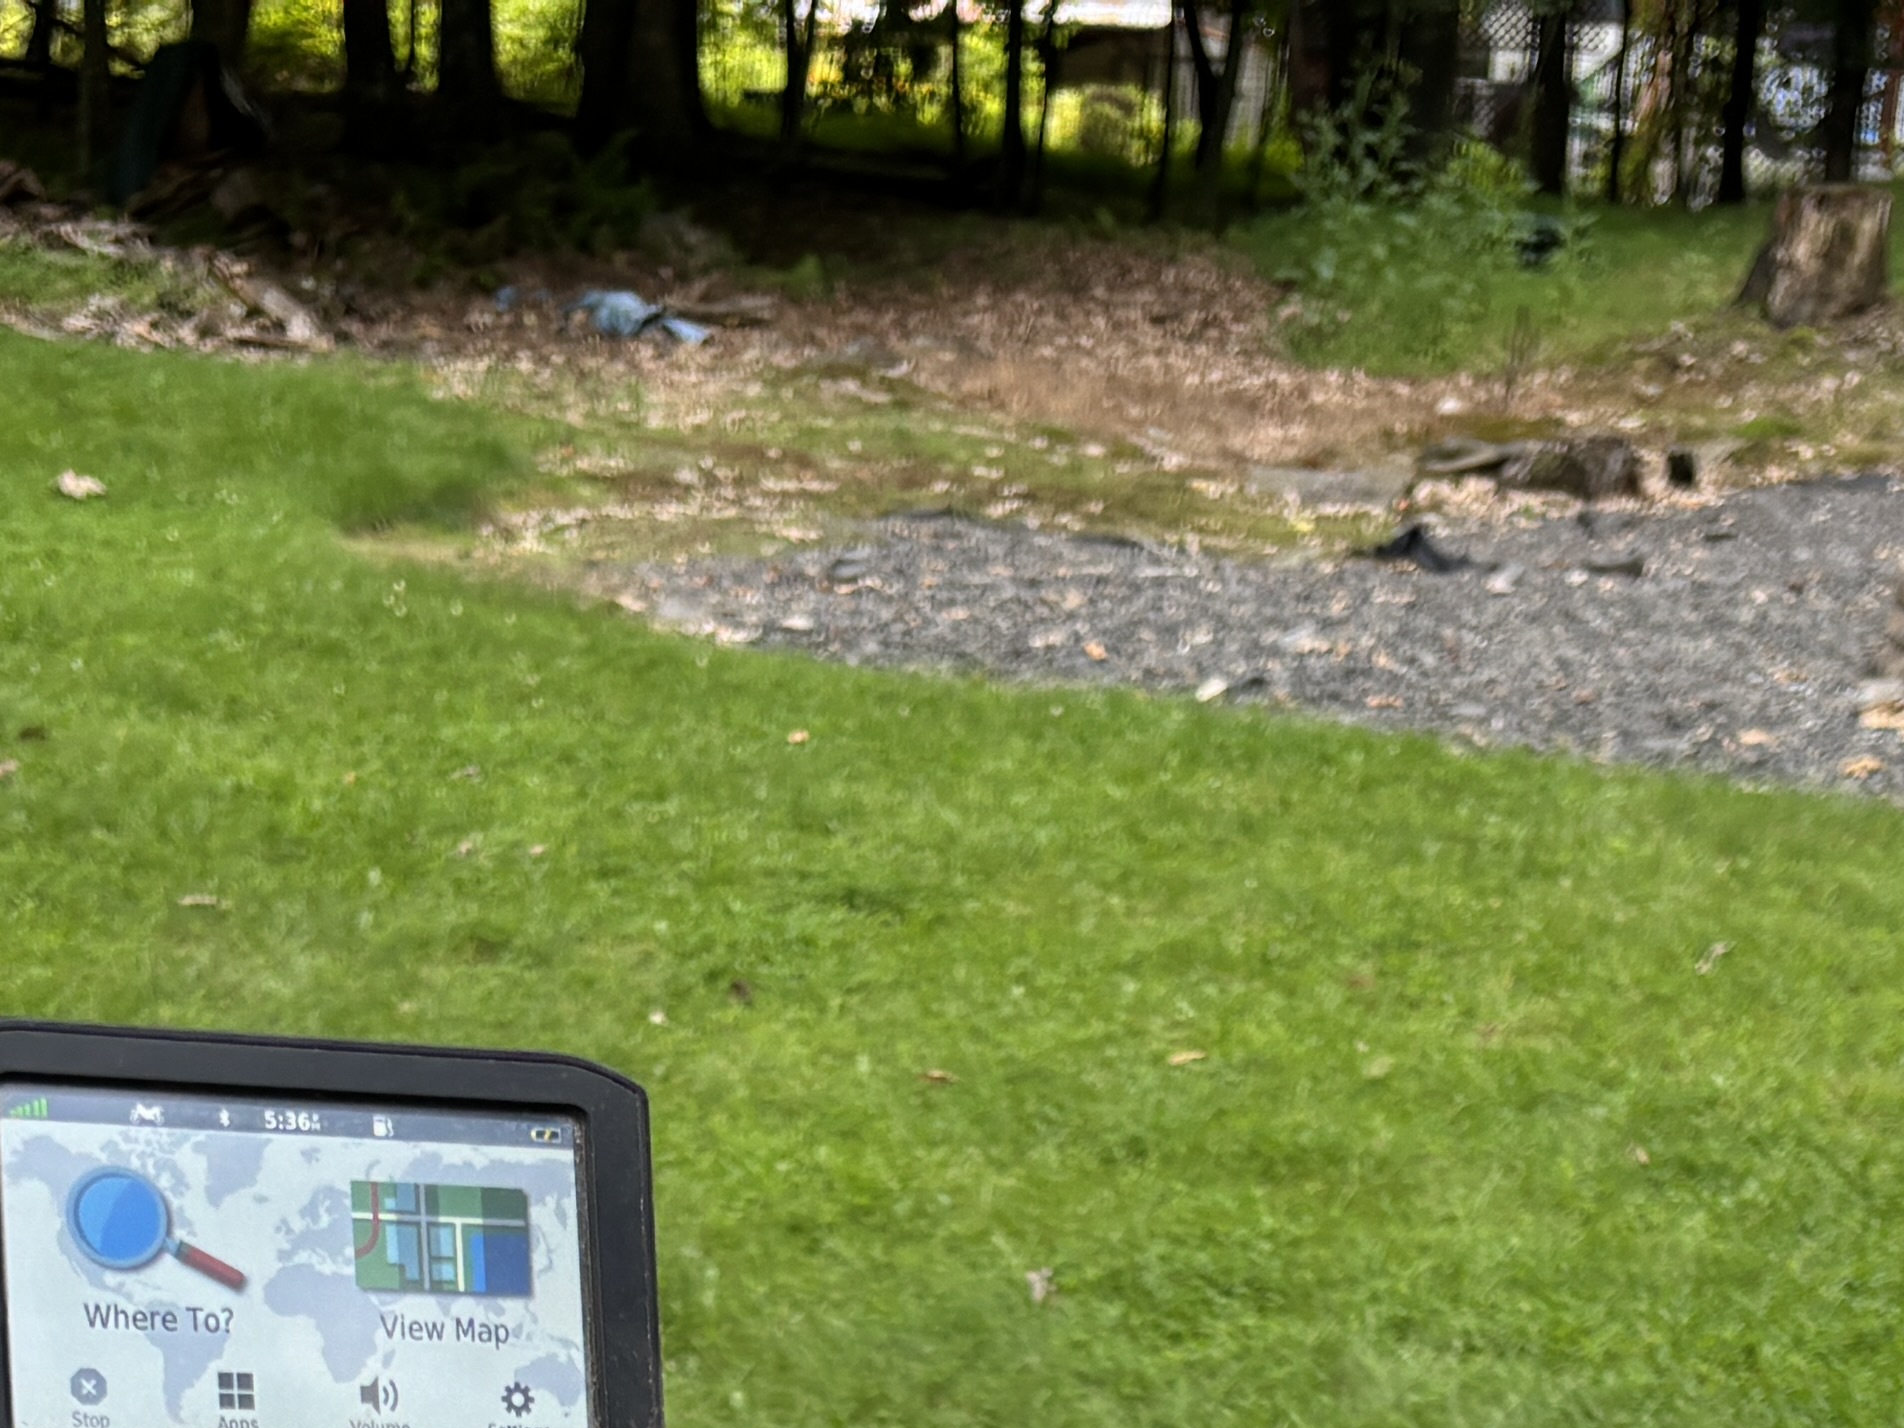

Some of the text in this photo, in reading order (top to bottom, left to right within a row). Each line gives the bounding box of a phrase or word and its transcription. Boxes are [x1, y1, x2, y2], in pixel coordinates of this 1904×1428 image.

[264, 1110, 311, 1131] 5:36
[84, 1303, 234, 1334] Where To?
[380, 1314, 510, 1350] View Map
